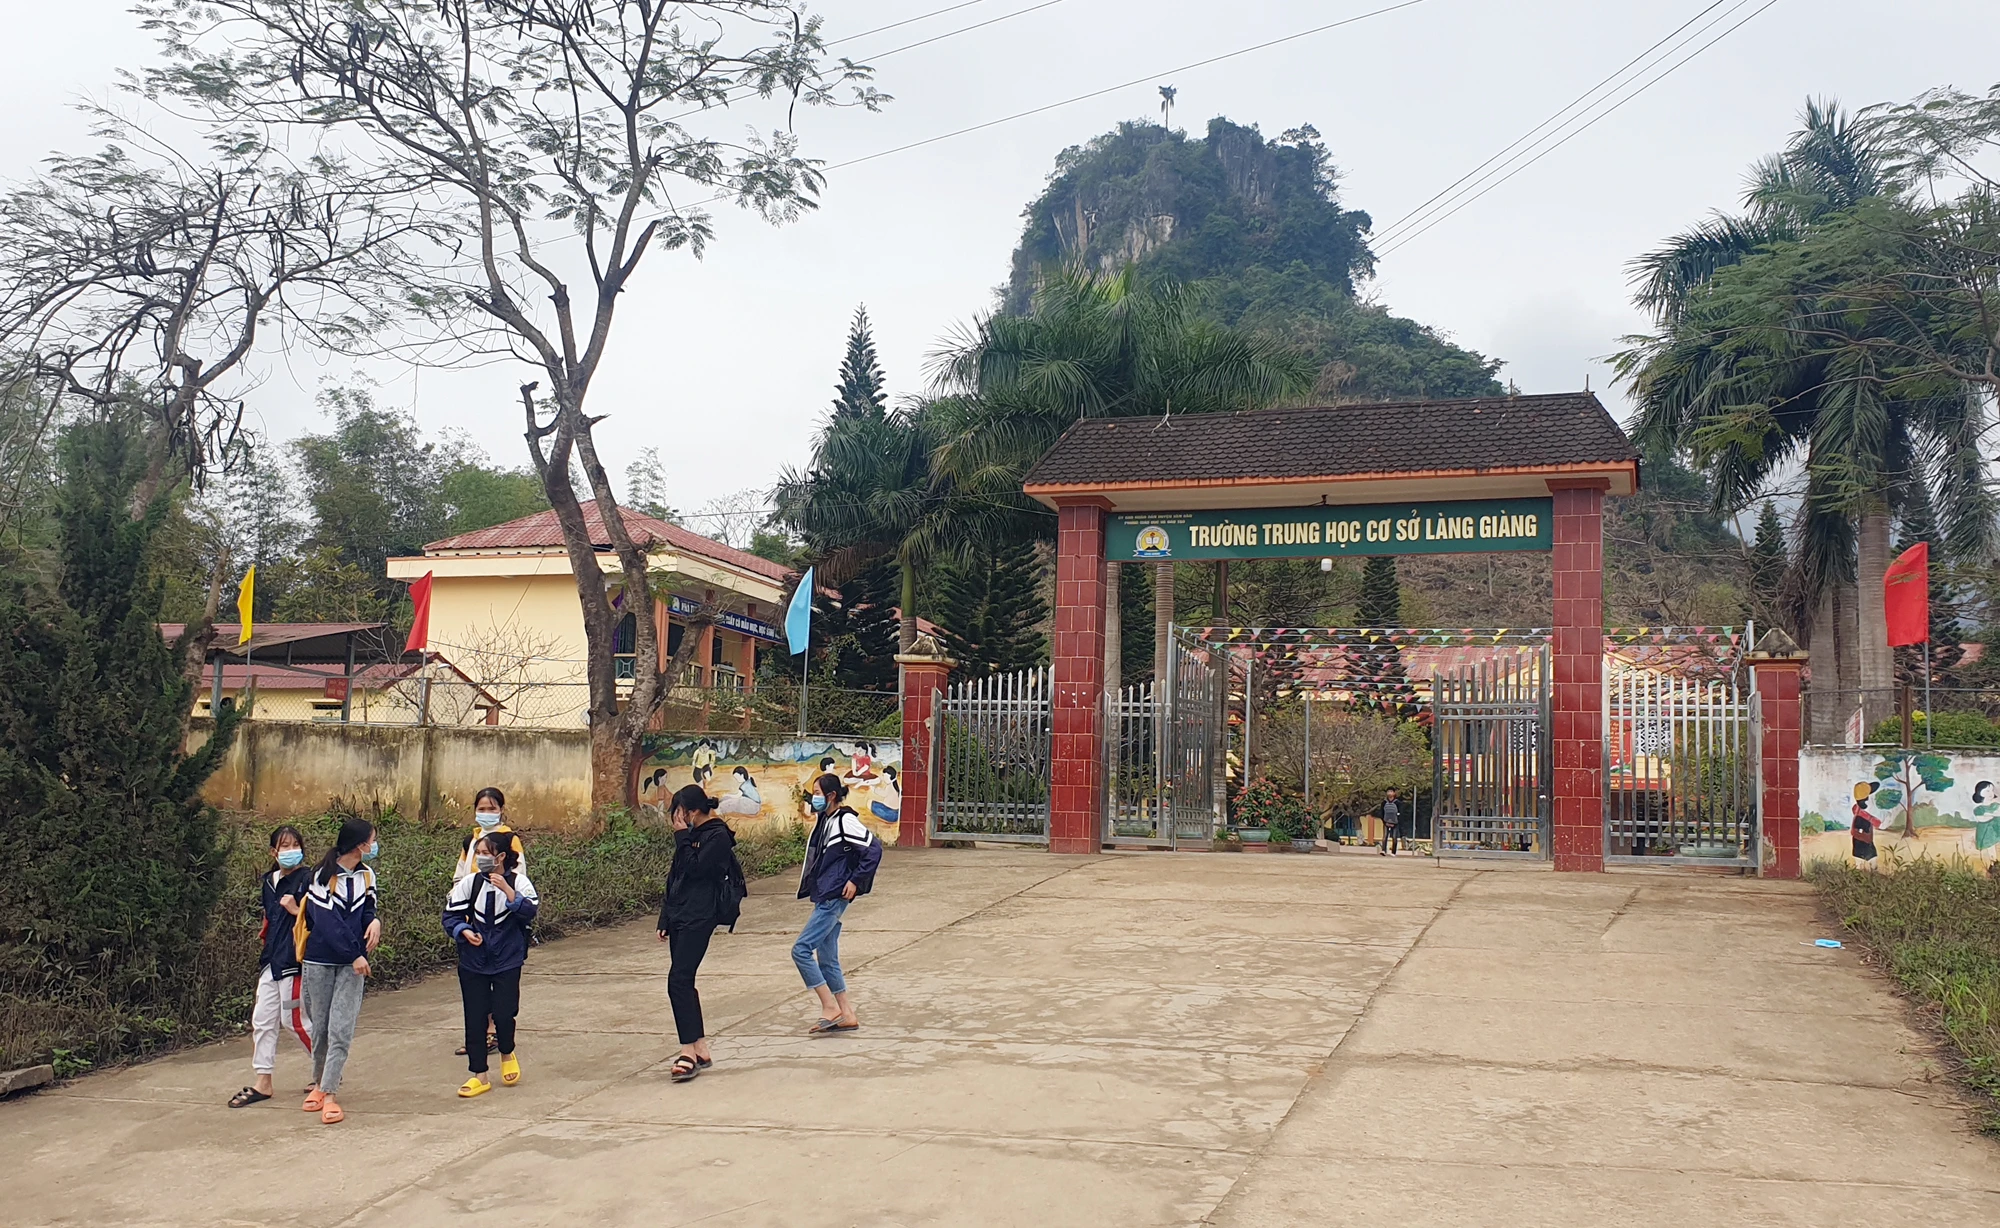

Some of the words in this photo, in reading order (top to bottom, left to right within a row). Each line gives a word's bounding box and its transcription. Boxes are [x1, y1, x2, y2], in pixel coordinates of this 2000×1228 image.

[1189, 519, 1257, 546] TRƯỜNG
[1262, 522, 1320, 545] TRUNG
[1325, 520, 1361, 548] HỌC
[1366, 518, 1392, 542] CƠ
[1395, 509, 1421, 541] SỞ
[1425, 512, 1474, 540] LÀNG
[1479, 509, 1537, 538] GIÀNG
